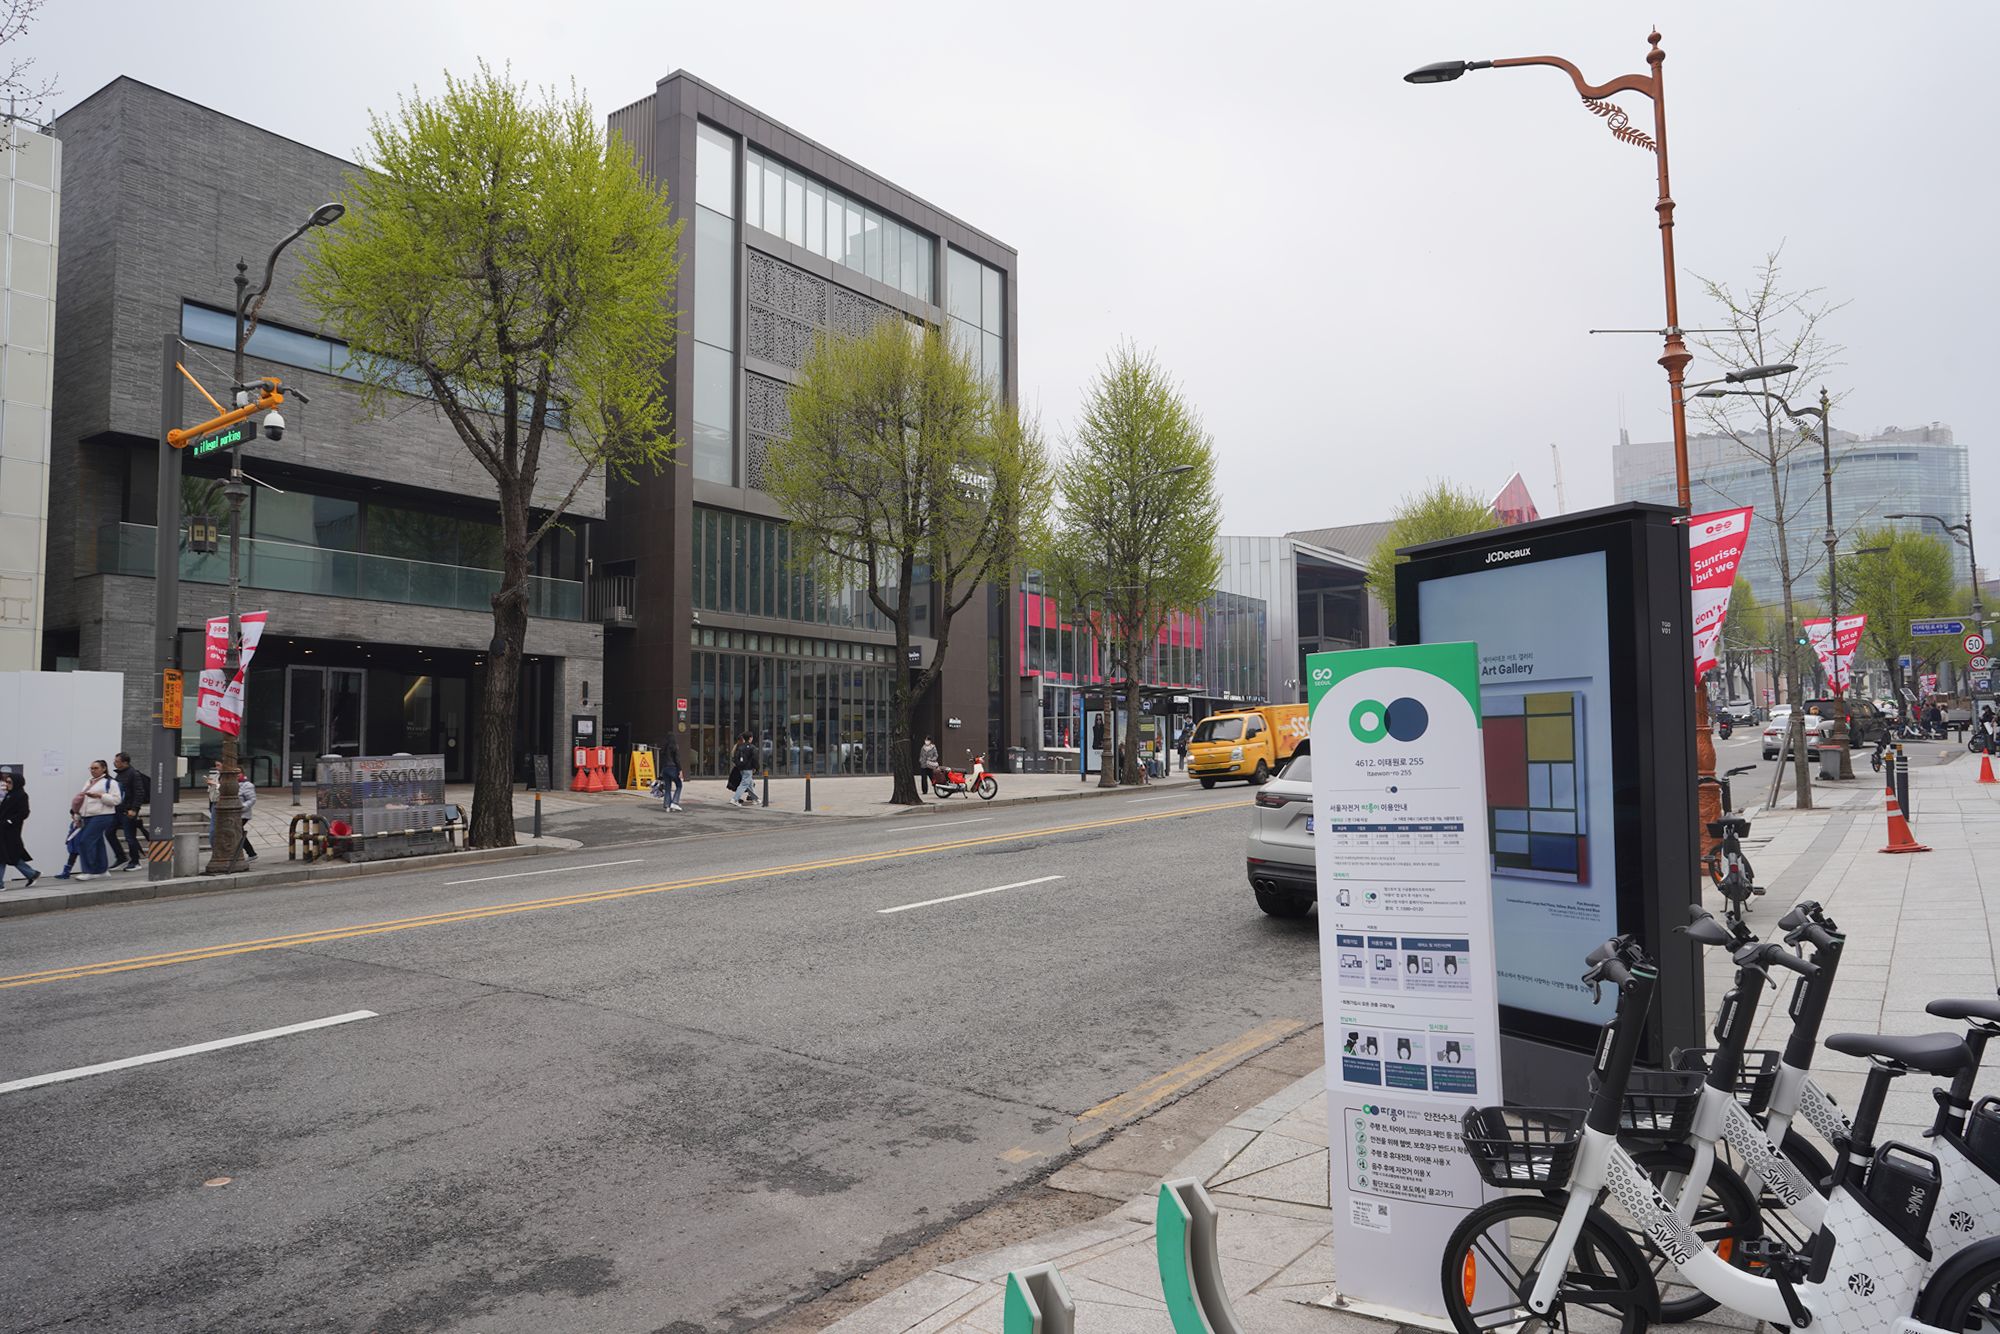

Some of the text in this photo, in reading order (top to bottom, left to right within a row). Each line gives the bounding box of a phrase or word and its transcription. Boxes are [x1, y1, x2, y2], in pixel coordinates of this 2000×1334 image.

[200, 436, 218, 454] illegal
[220, 430, 241, 446] parking
[1485, 547, 1531, 564] JCDecaux
[1694, 546, 1741, 571] Sunrise,
[1696, 561, 1734, 584] but we
[1842, 639, 1856, 648] your
[1968, 639, 1980, 650] 50
[1482, 663, 1533, 676] Art Gallery
[1973, 658, 1985, 667] 30
[1378, 758, 1407, 766] 이태원로
[1361, 803, 1380, 813] 따릉이
[1381, 1107, 1405, 1122] 따릉이
[1424, 1112, 1457, 1123] 안전수칙
[1370, 1122, 1380, 1131] 주행
[1389, 1125, 1407, 1134] 타이어,
[1409, 1128, 1432, 1136] 브레이크
[1433, 1130, 1445, 1138] 체인
[1370, 1136, 1386, 1145] 안전을
[1388, 1138, 1398, 1147] 위해
[1400, 1140, 1412, 1148] 헬멧,
[1414, 1142, 1437, 1151] 보호장구
[1438, 1144, 1456, 1154] 반드시
[1371, 1149, 1382, 1158] 주행
[1390, 1152, 1414, 1162] 휴대전화,
[1415, 1155, 1432, 1164] 이어폰
[1433, 1158, 1444, 1166] 사용
[1384, 1164, 1394, 1172] 후에
[1395, 1166, 1413, 1176] 자전거
[1414, 1169, 1425, 1178] 이용
[1372, 1179, 1401, 1191] 횡단보도와
[1402, 1183, 1426, 1194] 보도에서
[1428, 1188, 1454, 1198] 끌고가기
